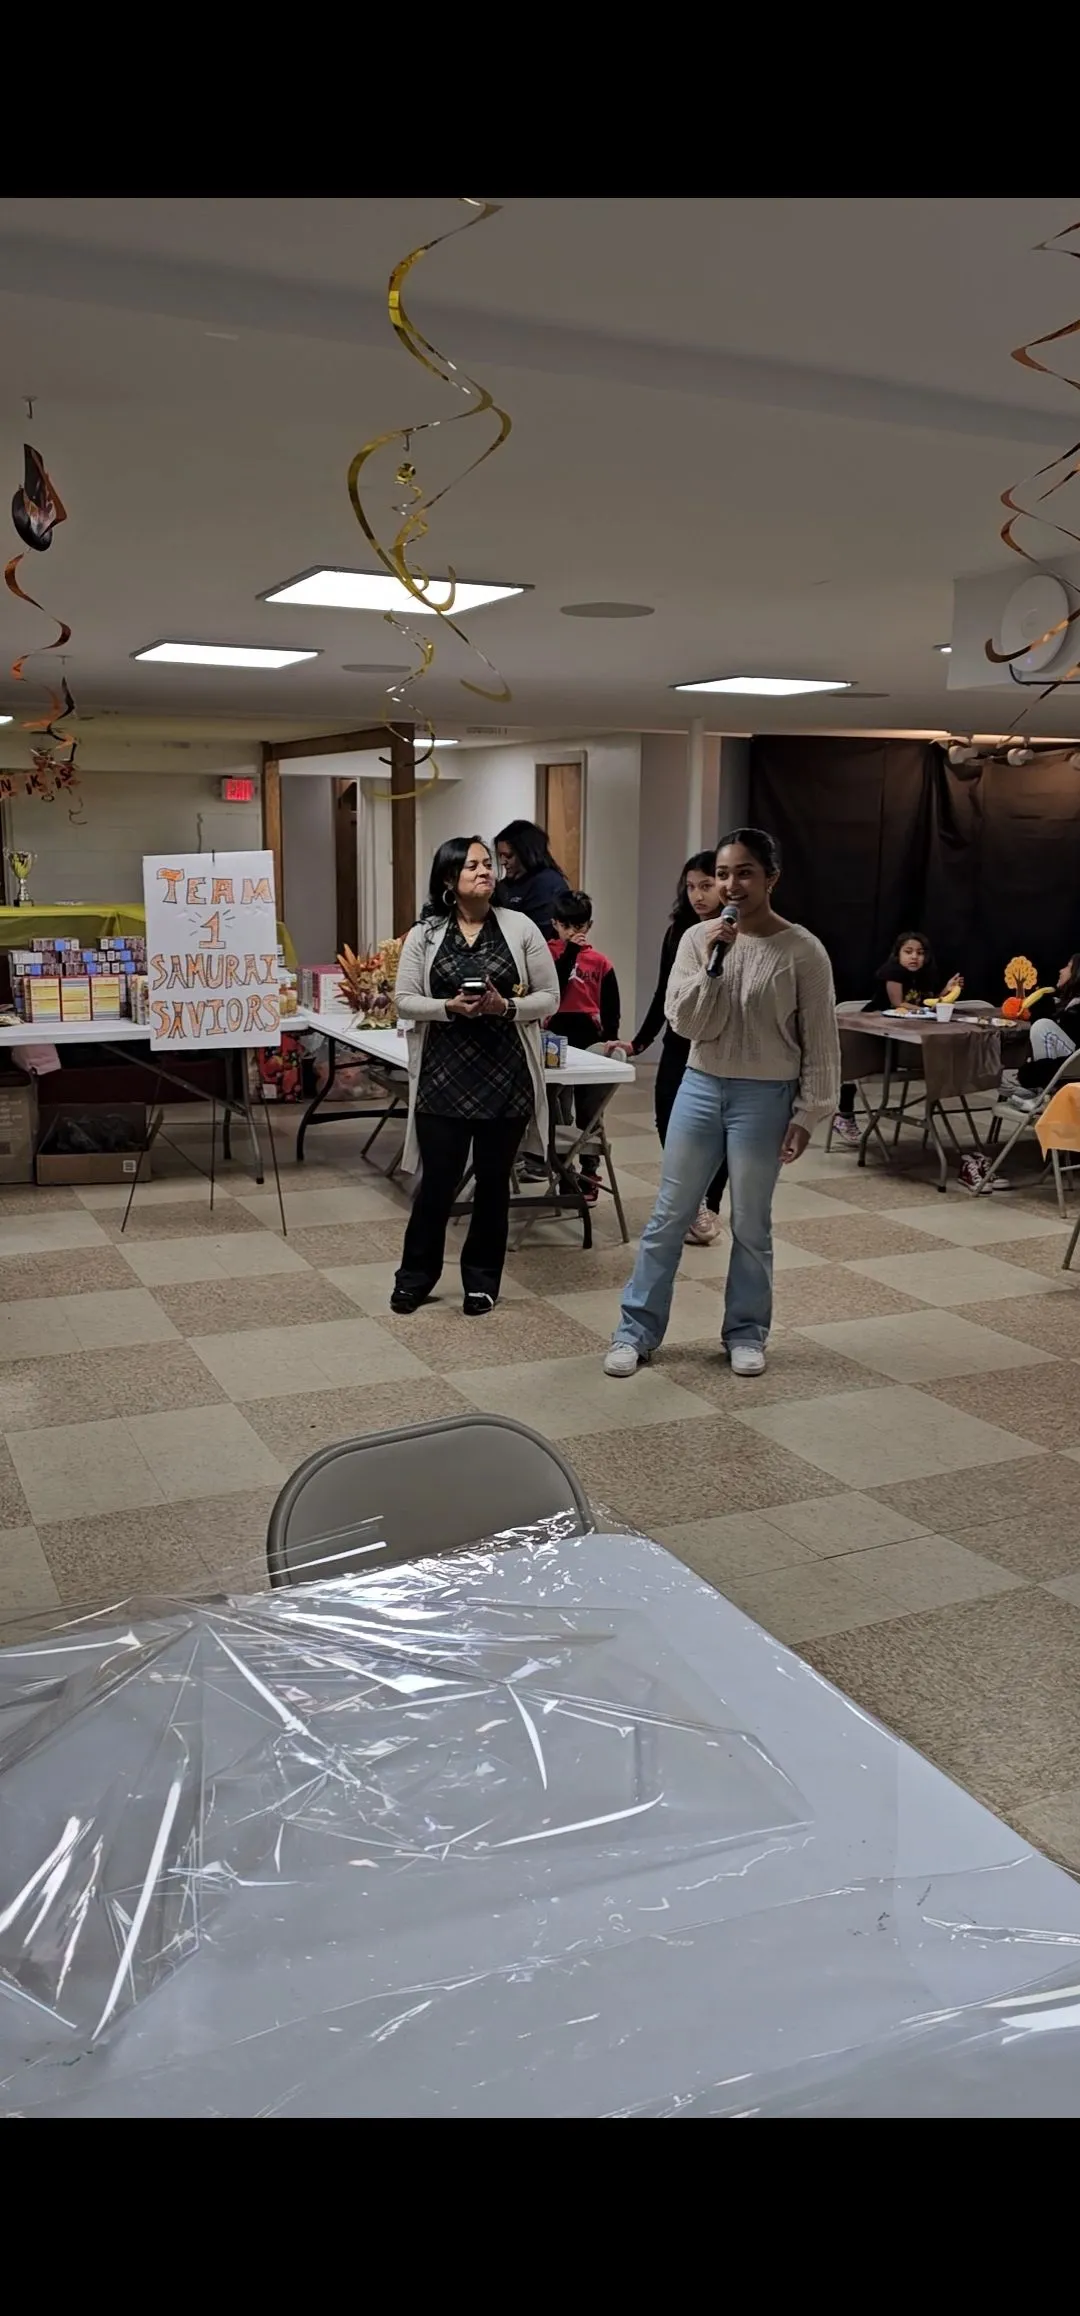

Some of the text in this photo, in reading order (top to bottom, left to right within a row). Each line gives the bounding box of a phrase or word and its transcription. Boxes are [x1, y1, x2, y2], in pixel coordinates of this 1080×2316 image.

[156, 868, 274, 904] TEAM
[200, 911, 226, 949] 1
[150, 954, 278, 990] SAMURAI
[151, 995, 280, 1039] SAVIORS
